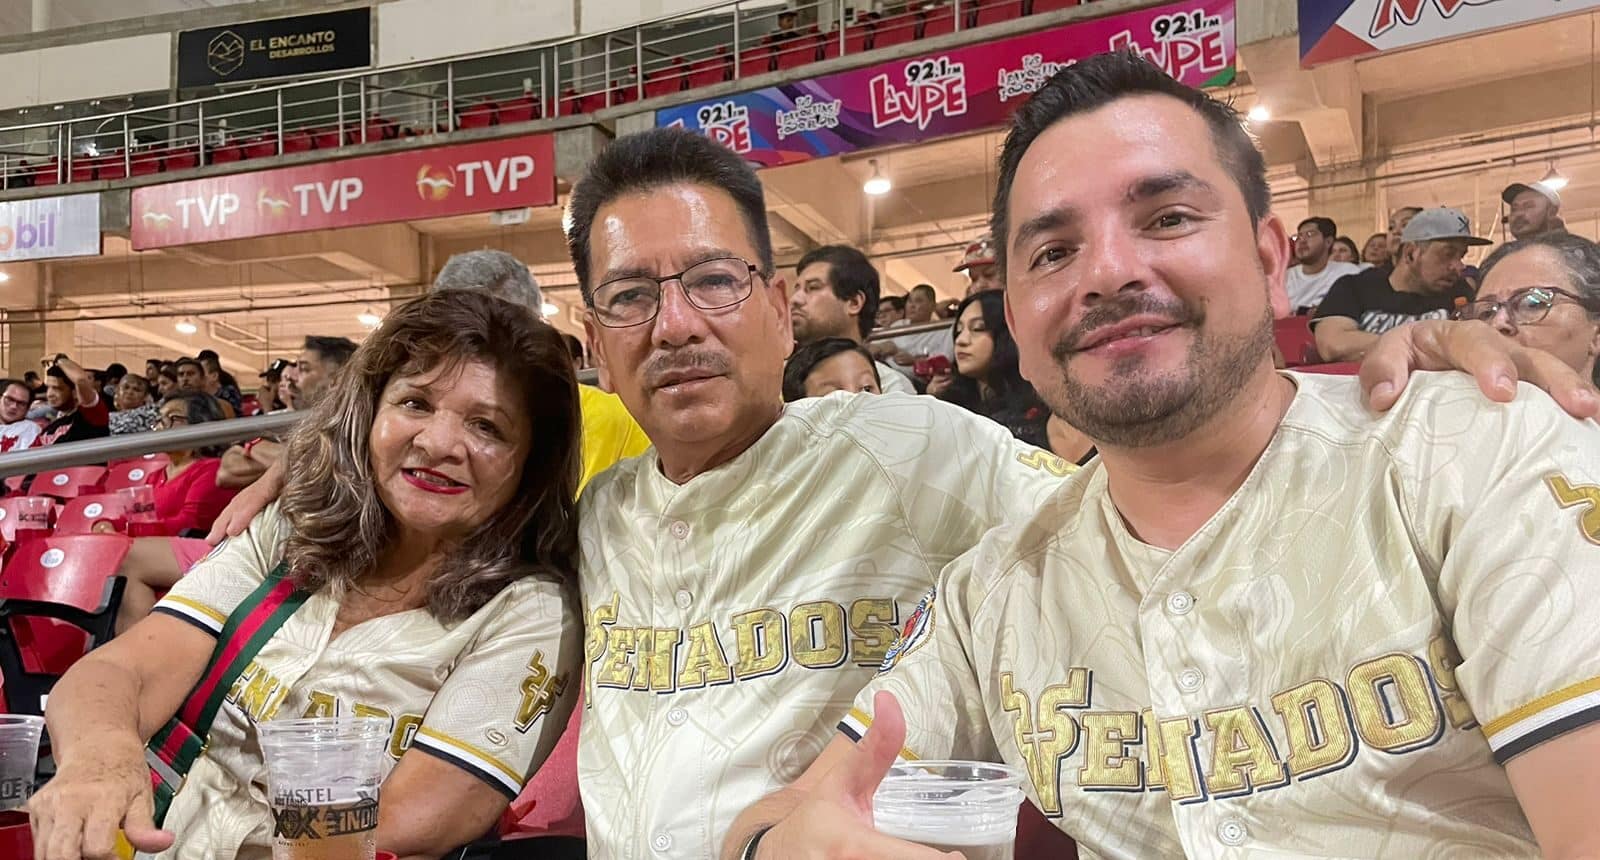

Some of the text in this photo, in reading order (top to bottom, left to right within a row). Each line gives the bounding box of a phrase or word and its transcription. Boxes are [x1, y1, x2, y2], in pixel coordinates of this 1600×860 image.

[249, 30, 336, 51] EL ENCANTO
[269, 43, 336, 60] DESARROLLOS
[457, 155, 534, 197] TVP
[176, 193, 240, 229] TVP
[293, 177, 363, 216] TVP
